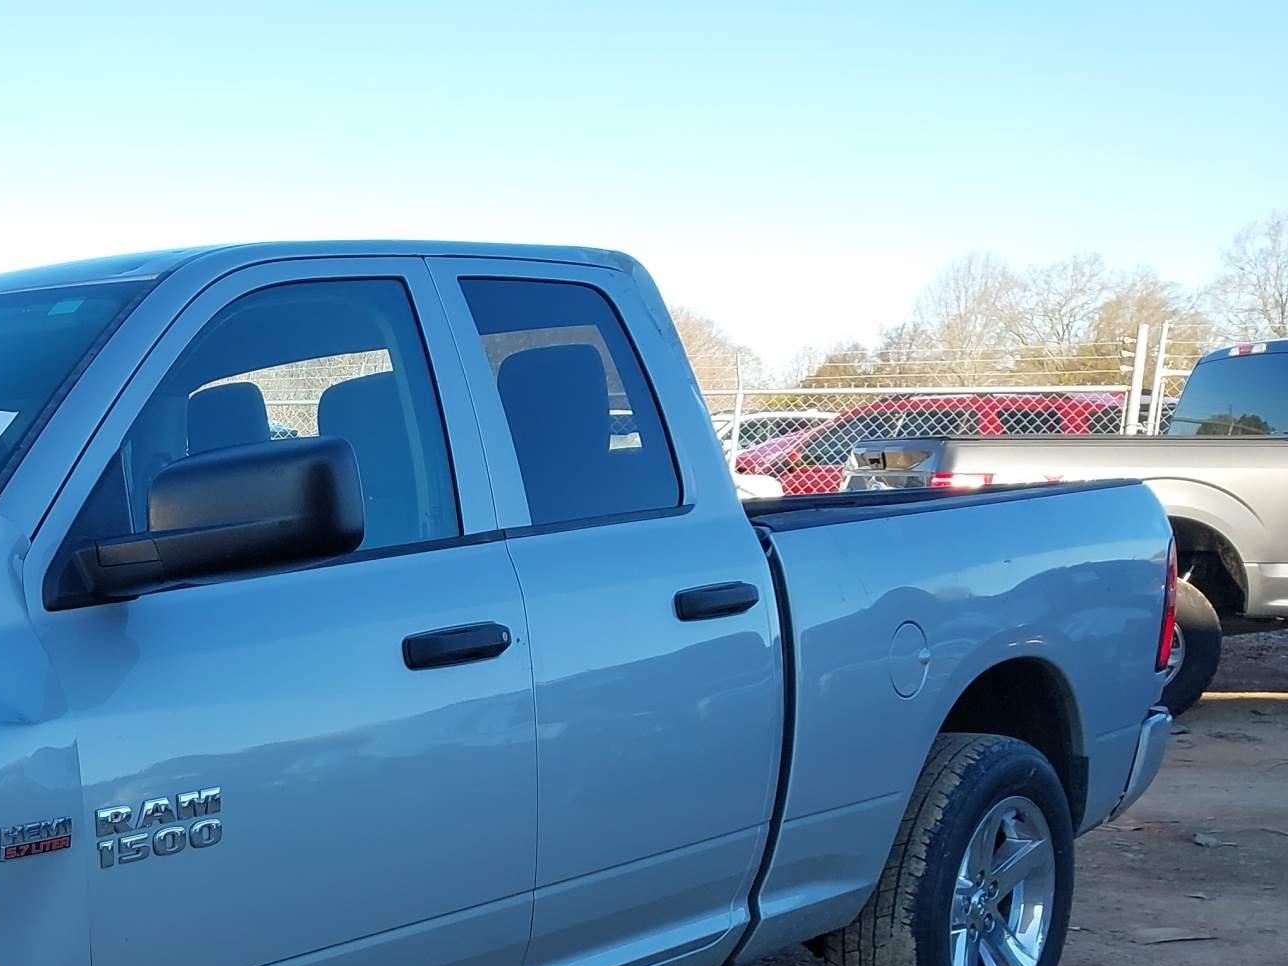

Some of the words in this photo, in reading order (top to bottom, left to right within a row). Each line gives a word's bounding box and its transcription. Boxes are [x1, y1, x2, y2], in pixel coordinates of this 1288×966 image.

[0, 816, 73, 847] HEMI
[94, 785, 222, 838] RAM
[6, 845, 29, 859] 5.7
[31, 837, 70, 854] LITER
[96, 818, 223, 869] 1500
